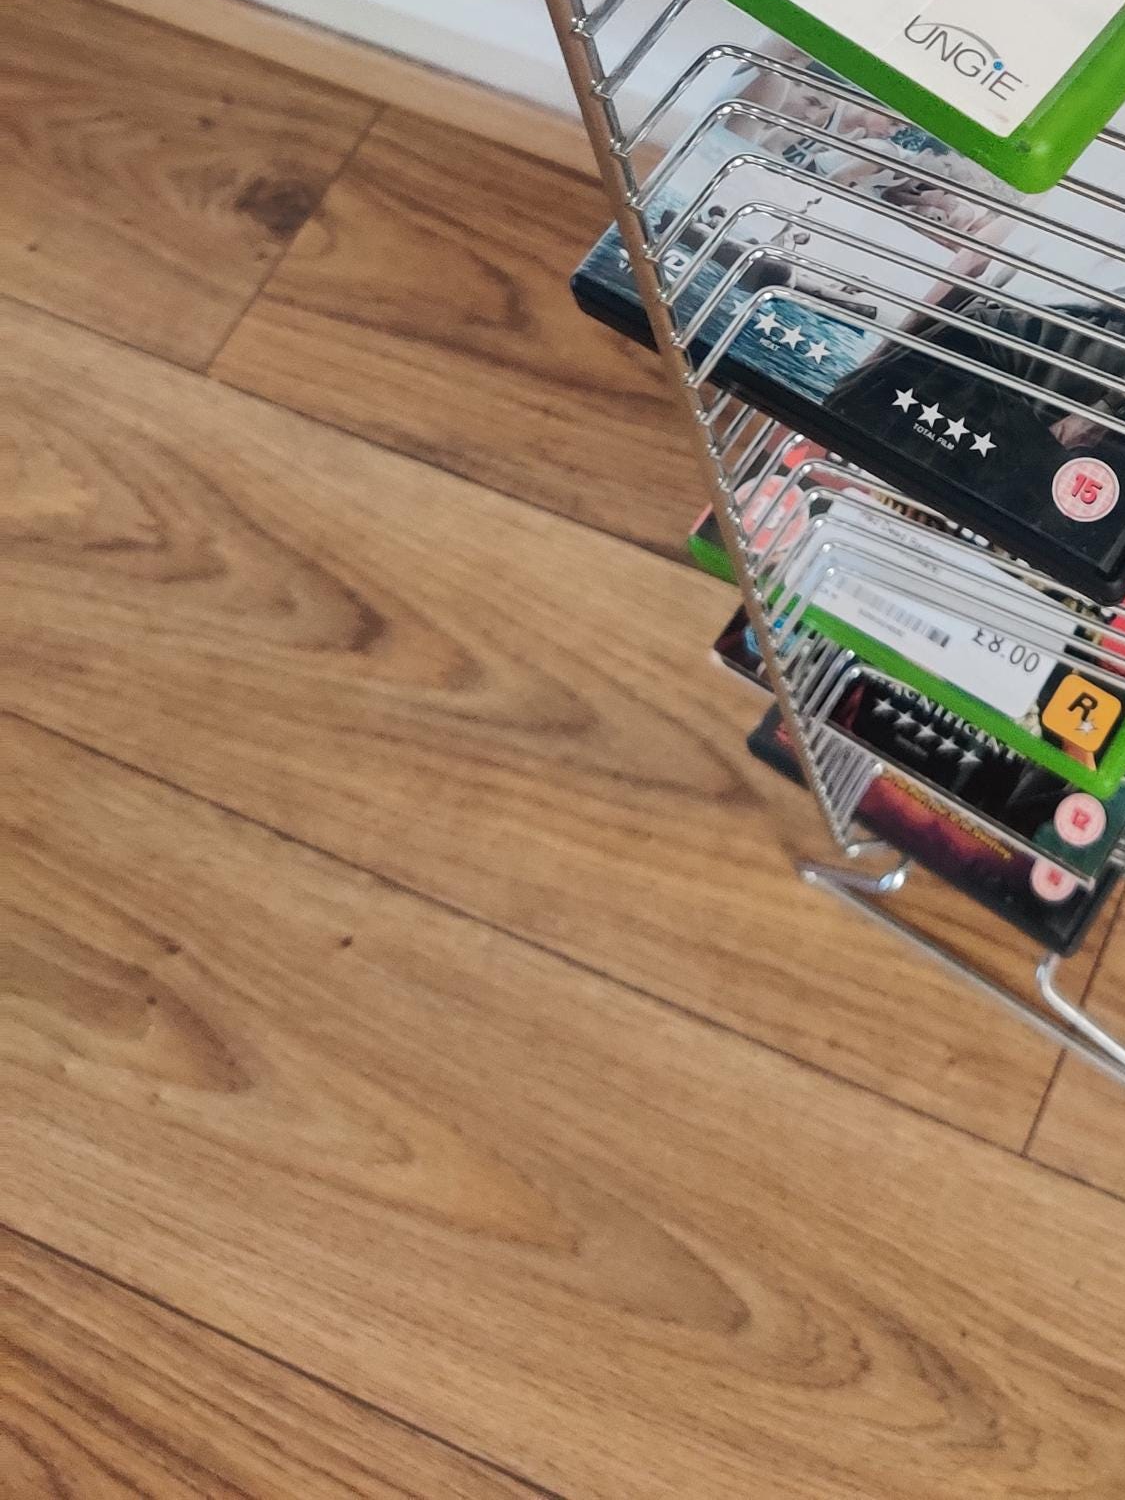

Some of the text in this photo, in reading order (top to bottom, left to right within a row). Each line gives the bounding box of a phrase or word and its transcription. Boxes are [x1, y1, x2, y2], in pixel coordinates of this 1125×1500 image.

[912, 422, 956, 450] TOTAL FILM
[1071, 474, 1103, 505] 15
[972, 628, 1041, 673] £8.00
[1067, 691, 1099, 721] R
